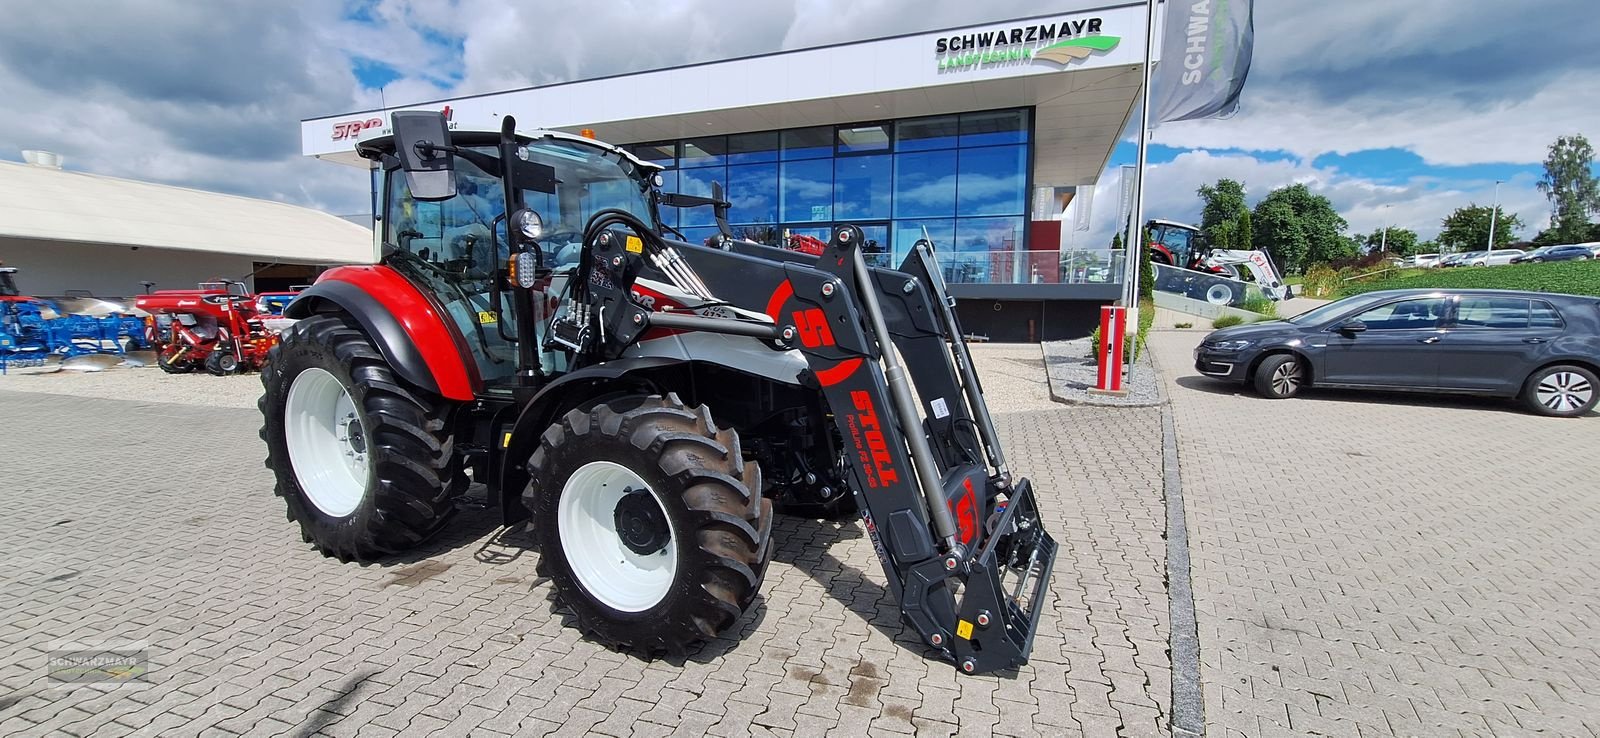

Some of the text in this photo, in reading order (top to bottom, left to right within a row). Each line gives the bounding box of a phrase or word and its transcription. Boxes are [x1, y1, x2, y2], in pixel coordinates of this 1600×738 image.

[936, 17, 1103, 53] SCHWARZMAYR
[938, 47, 1032, 69] LANDTECHNIK
[850, 391, 899, 487] STOLL
